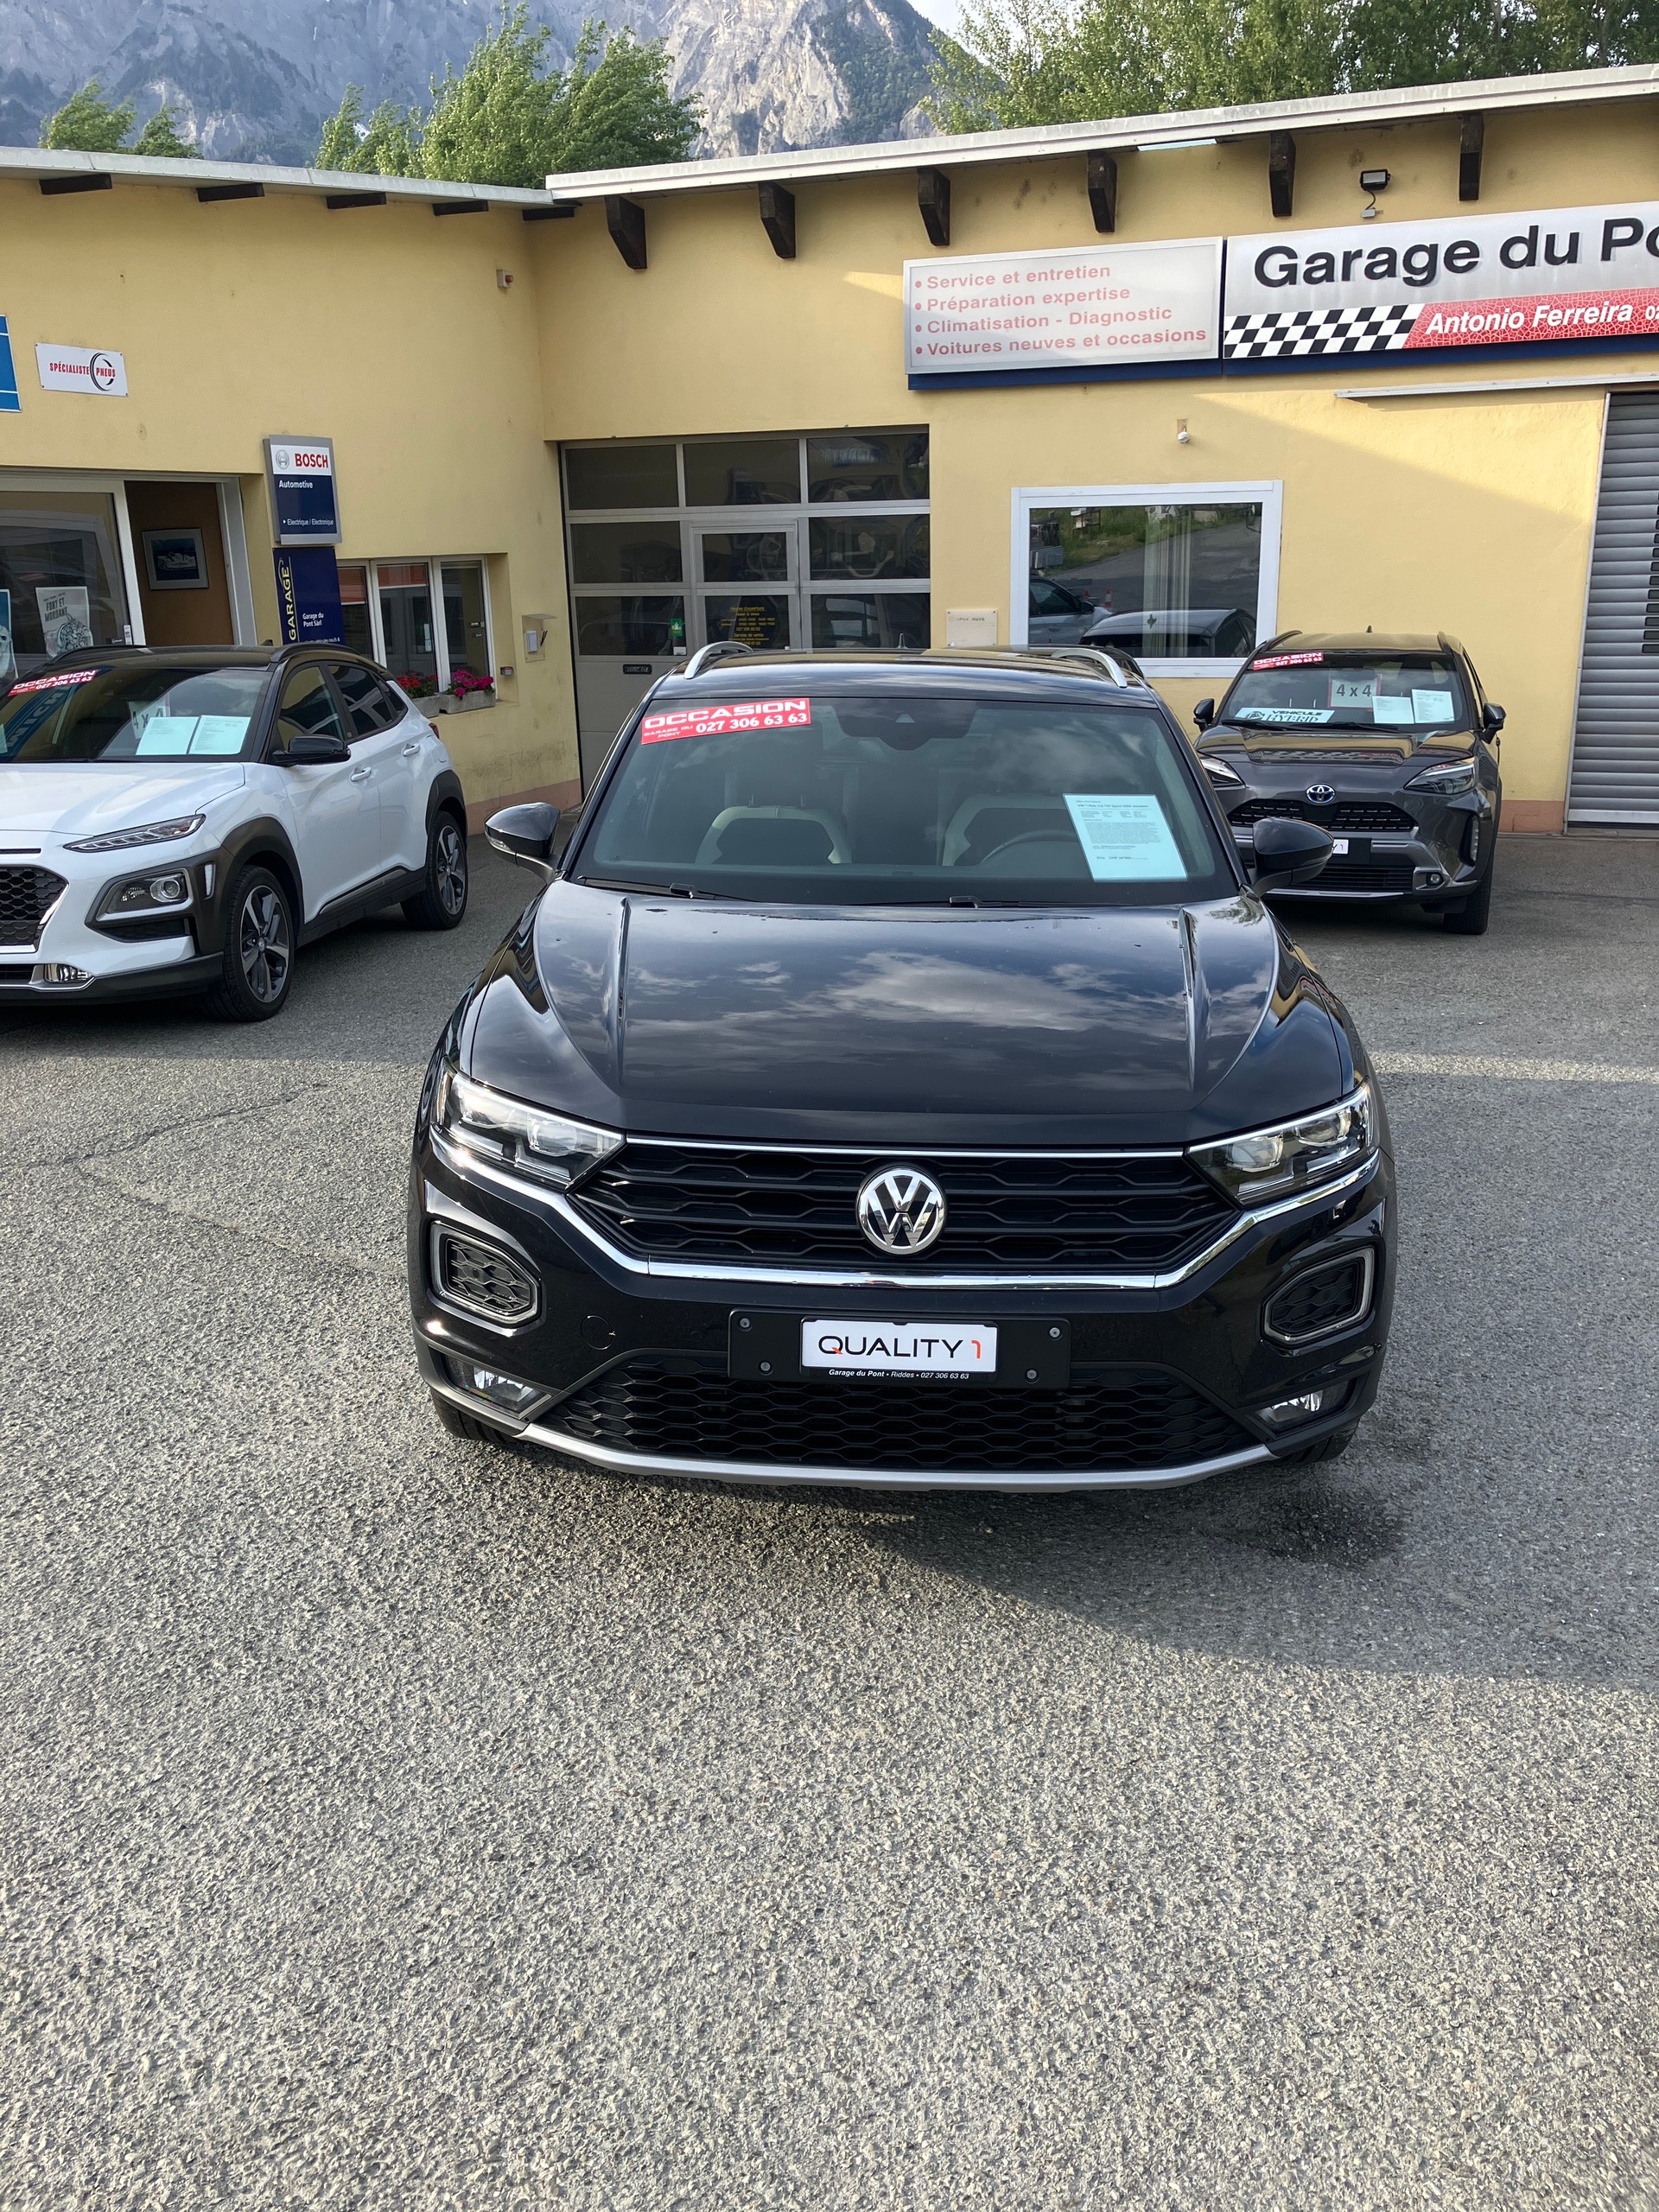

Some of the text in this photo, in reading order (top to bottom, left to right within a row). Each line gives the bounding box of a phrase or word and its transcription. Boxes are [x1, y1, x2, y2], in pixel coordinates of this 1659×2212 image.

[1254, 238, 1480, 288] Garage
[1499, 225, 1580, 270] du
[927, 265, 1111, 289] Service et entretien
[927, 287, 1131, 313] Préparation expertise
[927, 315, 1049, 334] Climatisation
[1069, 307, 1173, 327] Diagnostic
[1425, 308, 1525, 335] Antonio
[1532, 301, 1634, 327] Ferreira
[927, 329, 1207, 355] Voitures neuves et occasions
[49, 361, 116, 378] SPÉCIALISTE PNEUS
[295, 453, 328, 468] BOSCH
[279, 480, 314, 489] Automotive
[281, 567, 296, 641] GARAGE
[302, 613, 317, 621] Garage
[1253, 652, 1323, 665] OCCASION
[13, 670, 96, 690] OCCASION
[1336, 684, 1372, 697] 4 x 4
[644, 701, 807, 729] OCCASION
[696, 713, 808, 734] 027 306 63 63
[818, 1335, 982, 1359] QUALITY 1
[829, 1369, 855, 1378] Garage
[891, 1370, 914, 1379] Riddes
